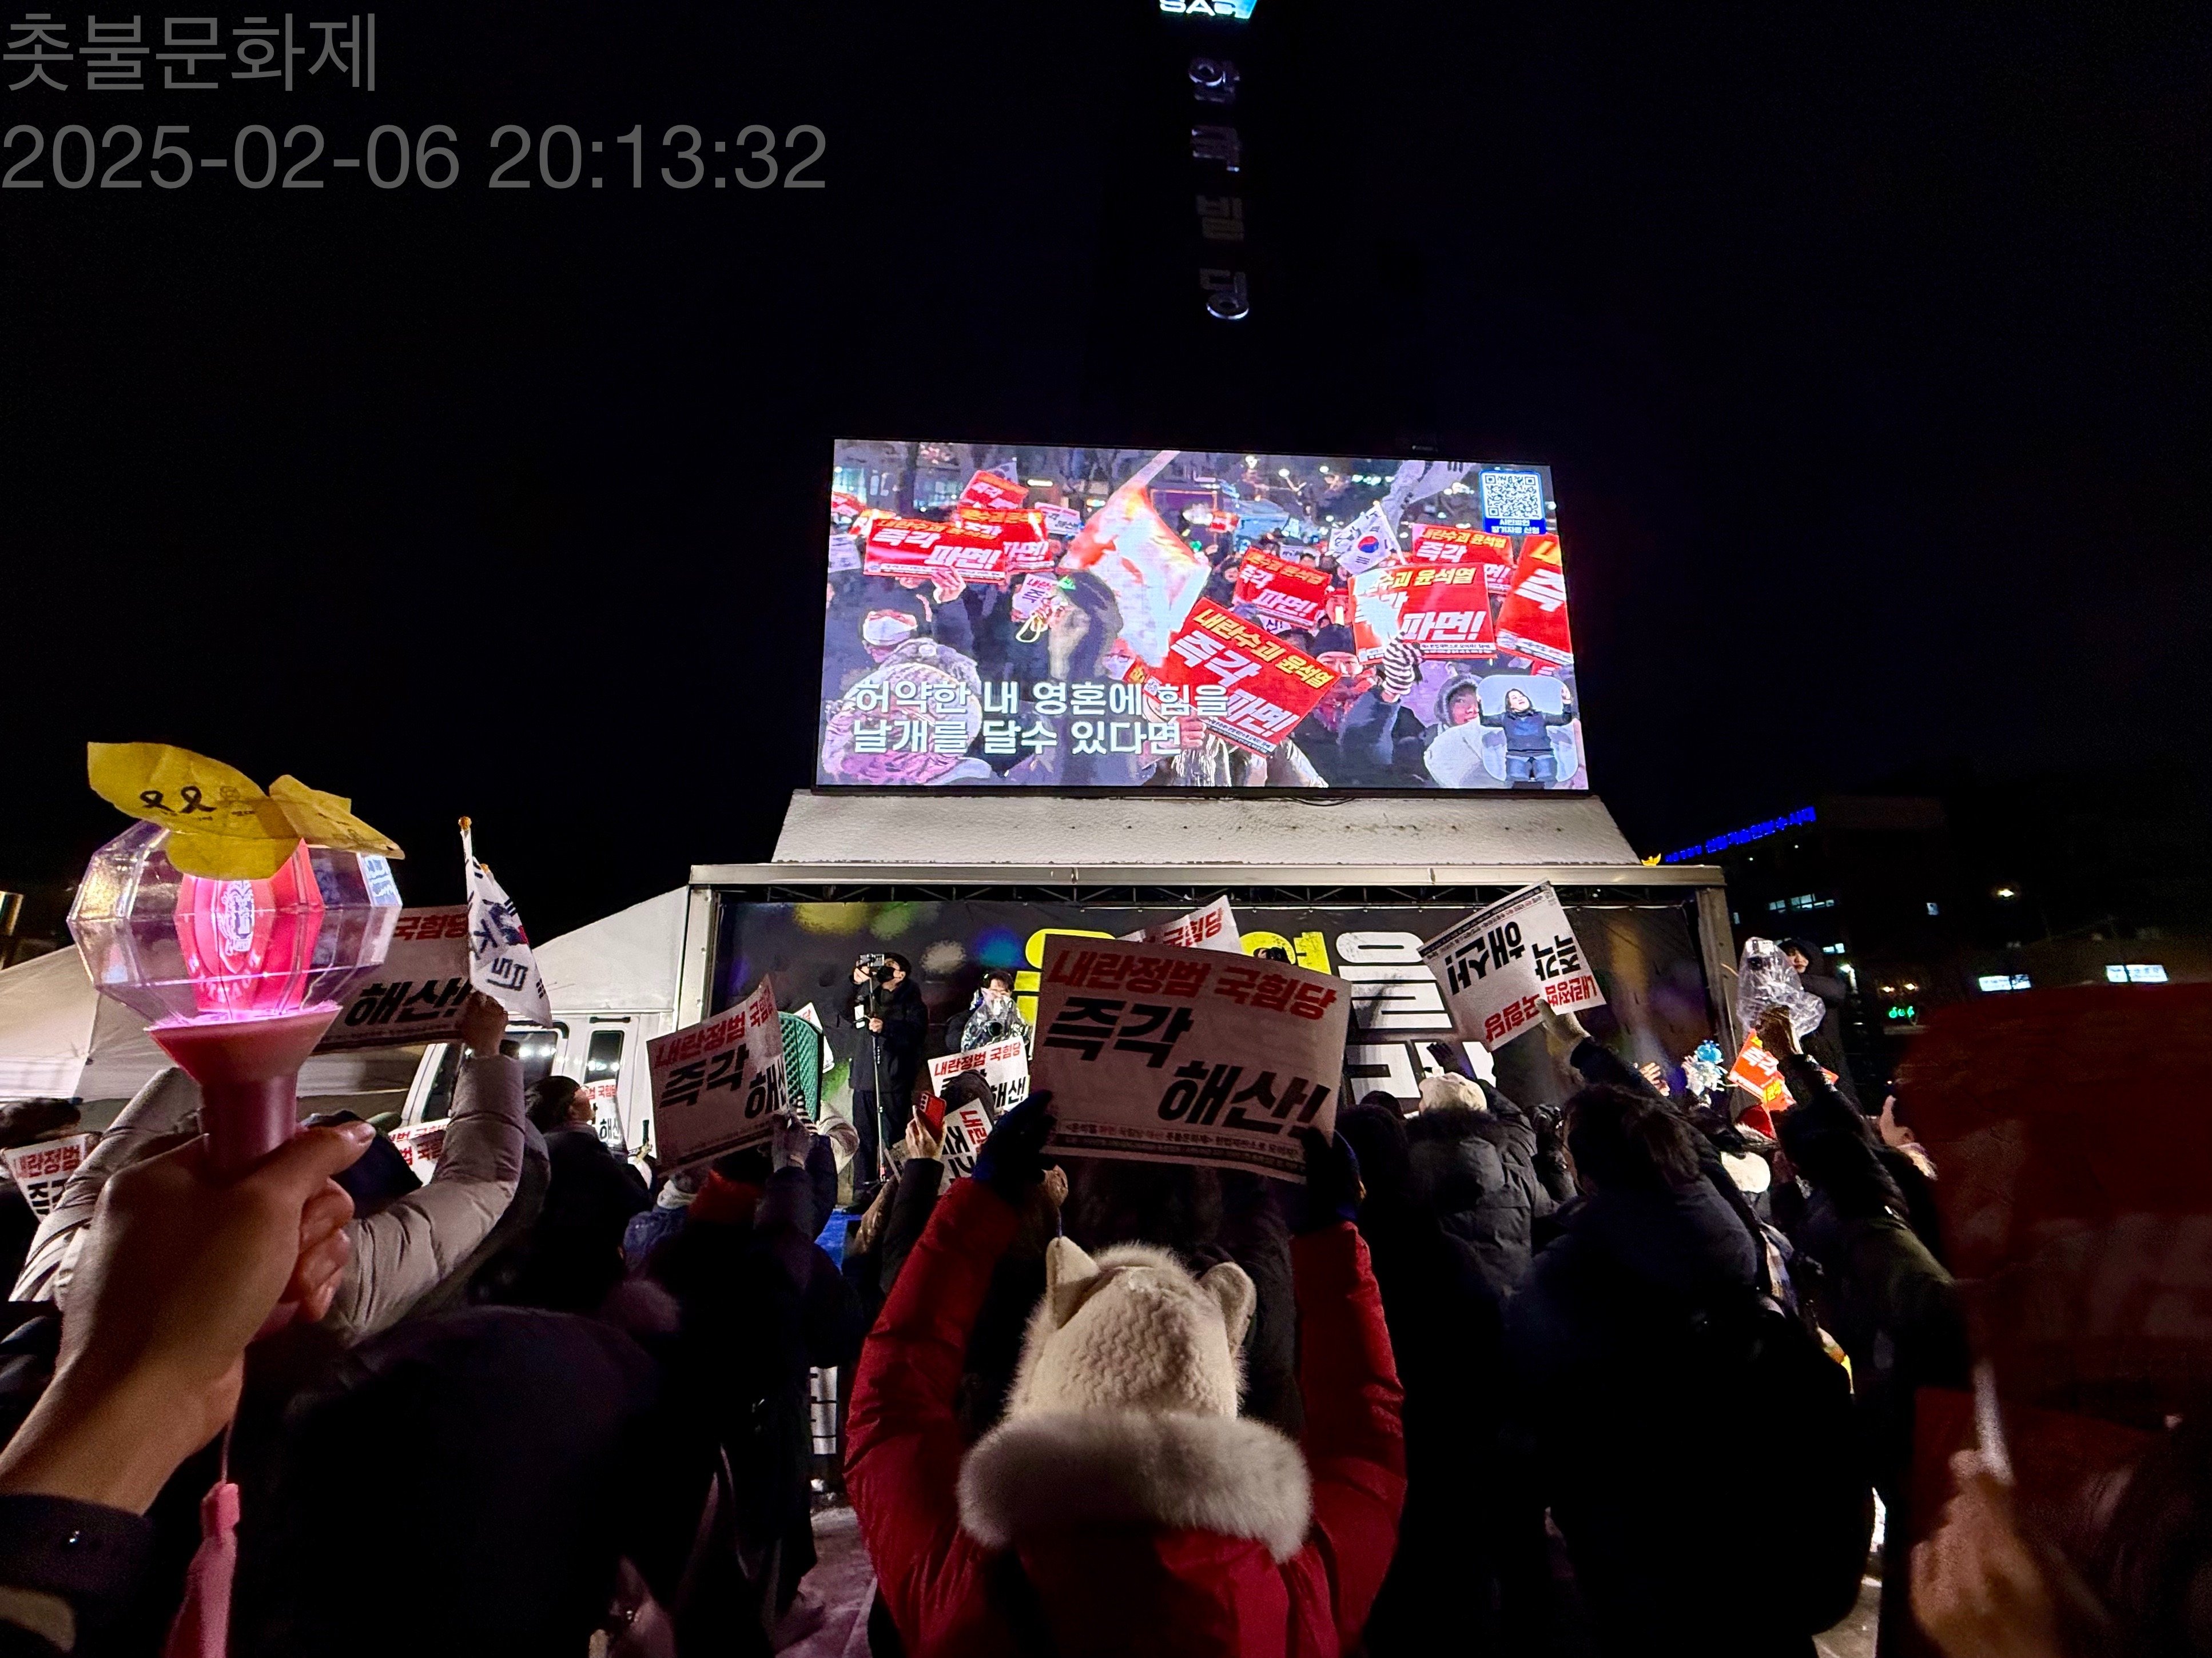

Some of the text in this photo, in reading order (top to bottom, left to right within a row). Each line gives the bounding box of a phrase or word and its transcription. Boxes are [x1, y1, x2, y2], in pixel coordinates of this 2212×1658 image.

[872, 528, 941, 548] 즉각
[1416, 541, 1468, 563] 즉각
[924, 545, 1002, 569] 파면!
[1483, 564, 1511, 584] 면!
[1239, 564, 1275, 589] 즉각
[1414, 567, 1477, 587] 윤석열
[1514, 568, 1566, 613] 즉
[1252, 589, 1318, 617] 파면!
[1266, 619, 1283, 632] 산!
[1403, 611, 1487, 641] 파면!
[1170, 630, 1263, 686] 즉각
[1192, 608, 1335, 689] 내란수괴 윤석열
[857, 680, 1228, 716] 허약한 내 영혼에 힘을
[1227, 688, 1300, 738] 파면!
[853, 720, 1181, 755] 날개를 달수 있다면
[394, 912, 468, 940] 국힘당
[1163, 907, 1223, 947] 국힘당
[1445, 921, 1525, 996] 해산!
[1531, 935, 1581, 982] 즉각
[344, 977, 474, 1026] 해산!
[1047, 950, 1337, 1021] 내란정범 국힘당
[654, 984, 775, 1069] 내란정범 국힘당
[1484, 974, 1598, 1043] 내란정범 국힘당
[1043, 997, 1194, 1069] 즉각
[659, 1043, 749, 1108] 즉각
[934, 1041, 1021, 1077] 내란정범 국힘당
[991, 1075, 1027, 1108] 해산!
[1158, 1061, 1331, 1140] 해산!
[960, 1110, 988, 1146] 내란
